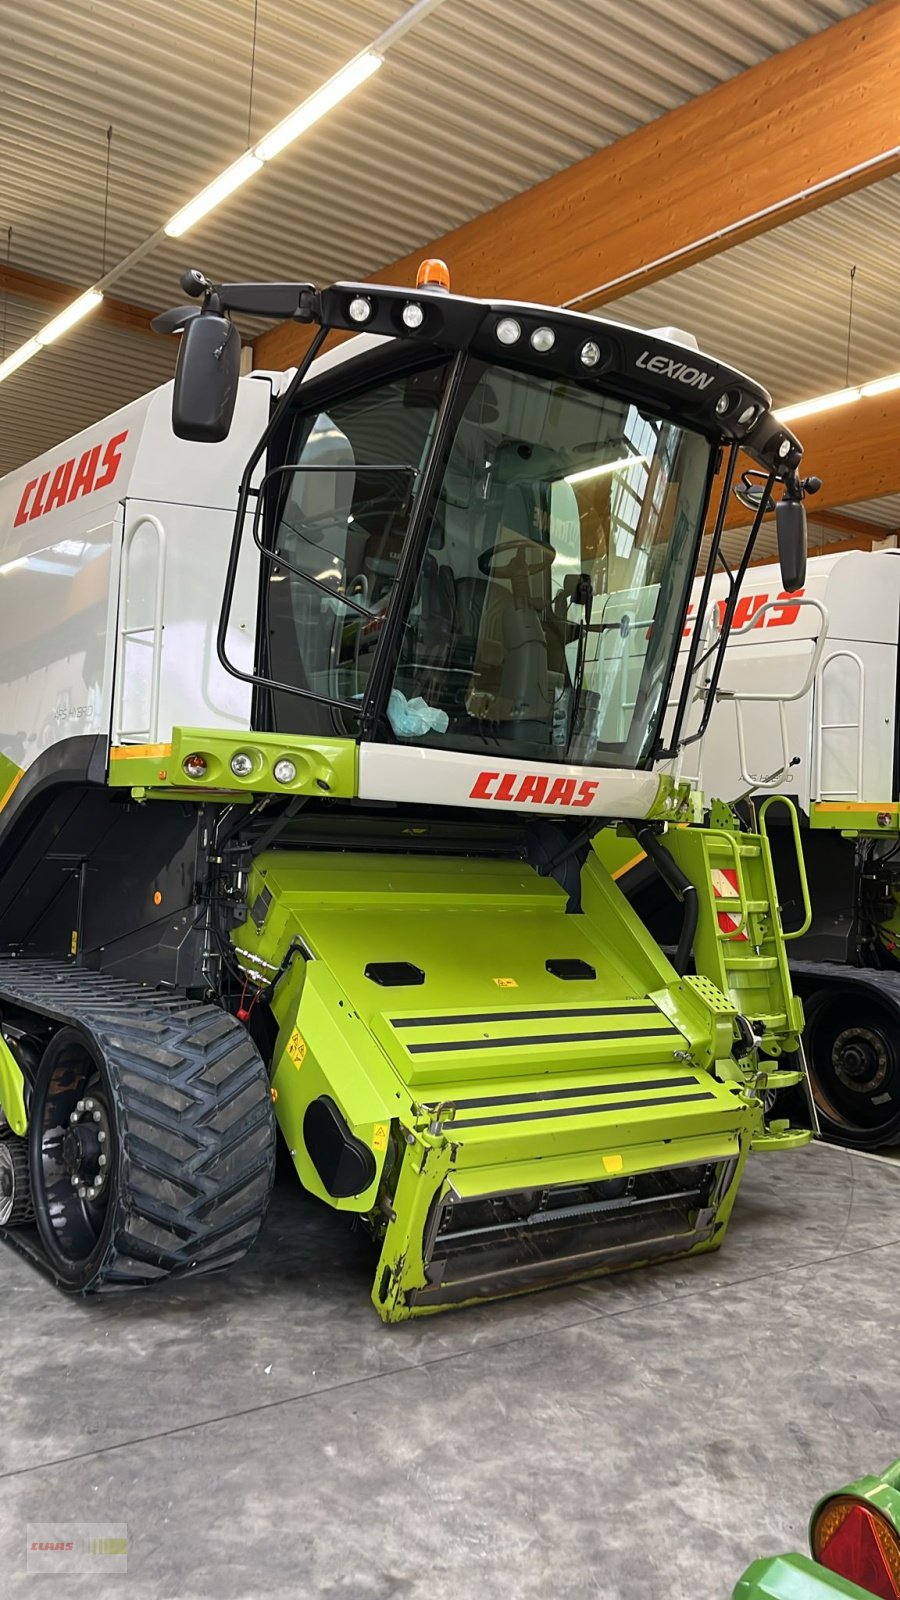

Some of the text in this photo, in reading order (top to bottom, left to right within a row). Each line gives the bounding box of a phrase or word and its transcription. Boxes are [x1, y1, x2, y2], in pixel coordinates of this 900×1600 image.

[635, 351, 715, 390] LEXION
[14, 429, 128, 528] CLAAS
[469, 772, 599, 807] CLAAS
